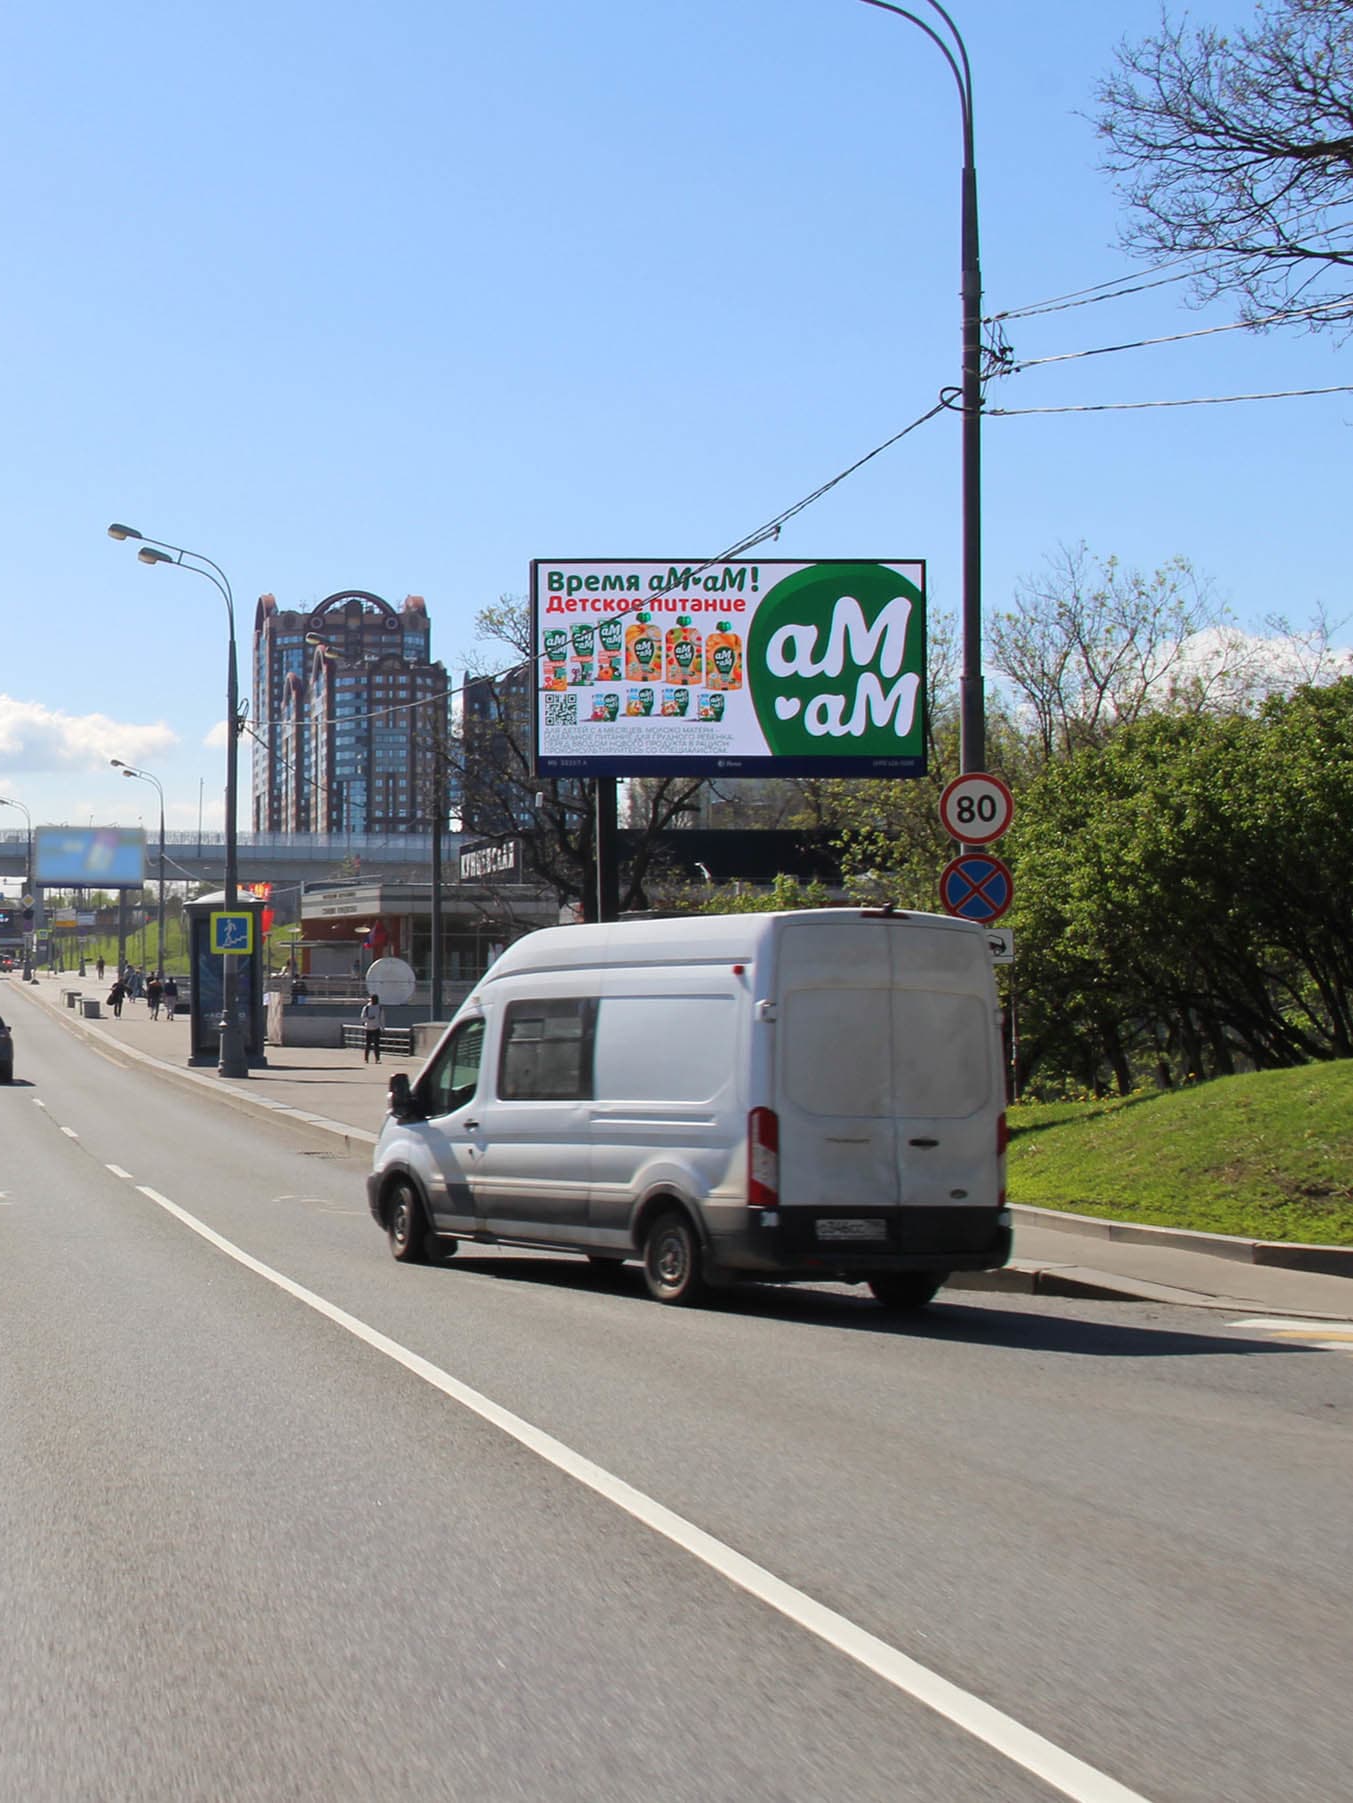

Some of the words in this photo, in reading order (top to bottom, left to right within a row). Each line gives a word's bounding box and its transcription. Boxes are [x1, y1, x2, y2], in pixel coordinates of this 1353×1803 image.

[547, 571, 640, 597] Время
[545, 596, 643, 613] Детское
[649, 597, 746, 613] питание
[957, 794, 996, 823] 80
